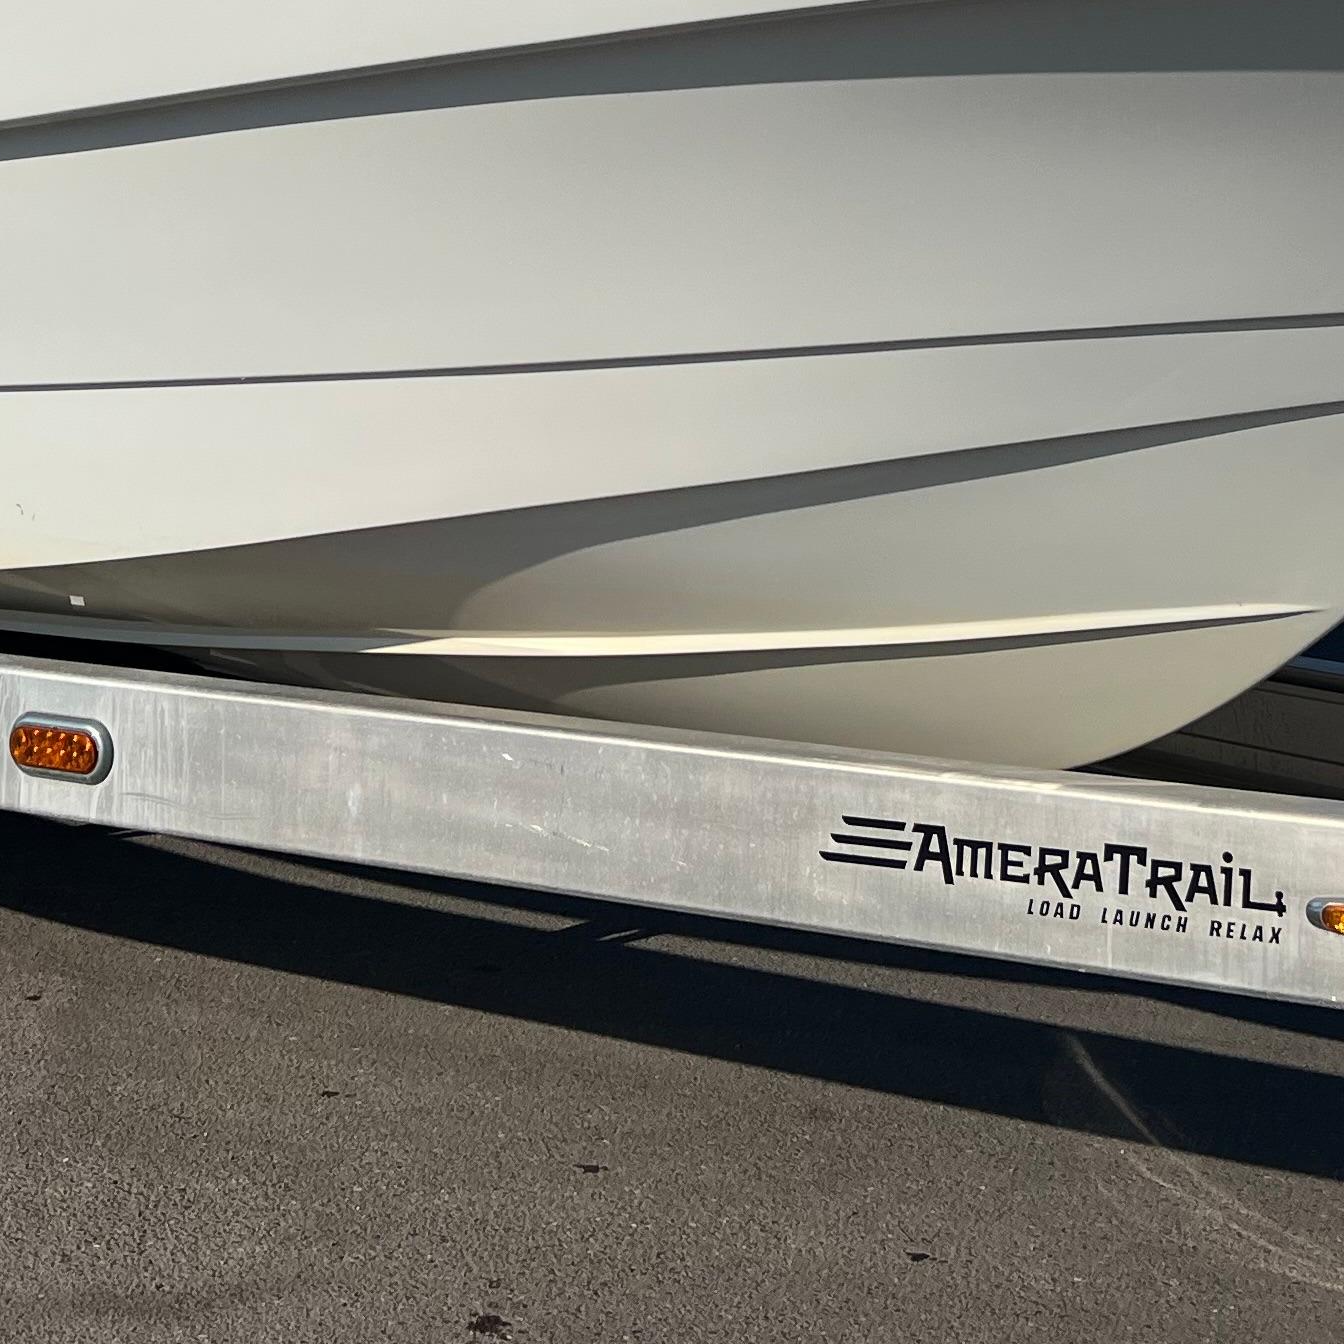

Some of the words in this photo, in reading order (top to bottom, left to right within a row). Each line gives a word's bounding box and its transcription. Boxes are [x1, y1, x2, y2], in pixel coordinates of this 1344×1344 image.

[1027, 898, 1081, 921] LOAD
[1100, 907, 1188, 933] LAUNCH
[1209, 919, 1282, 945] RELAX
